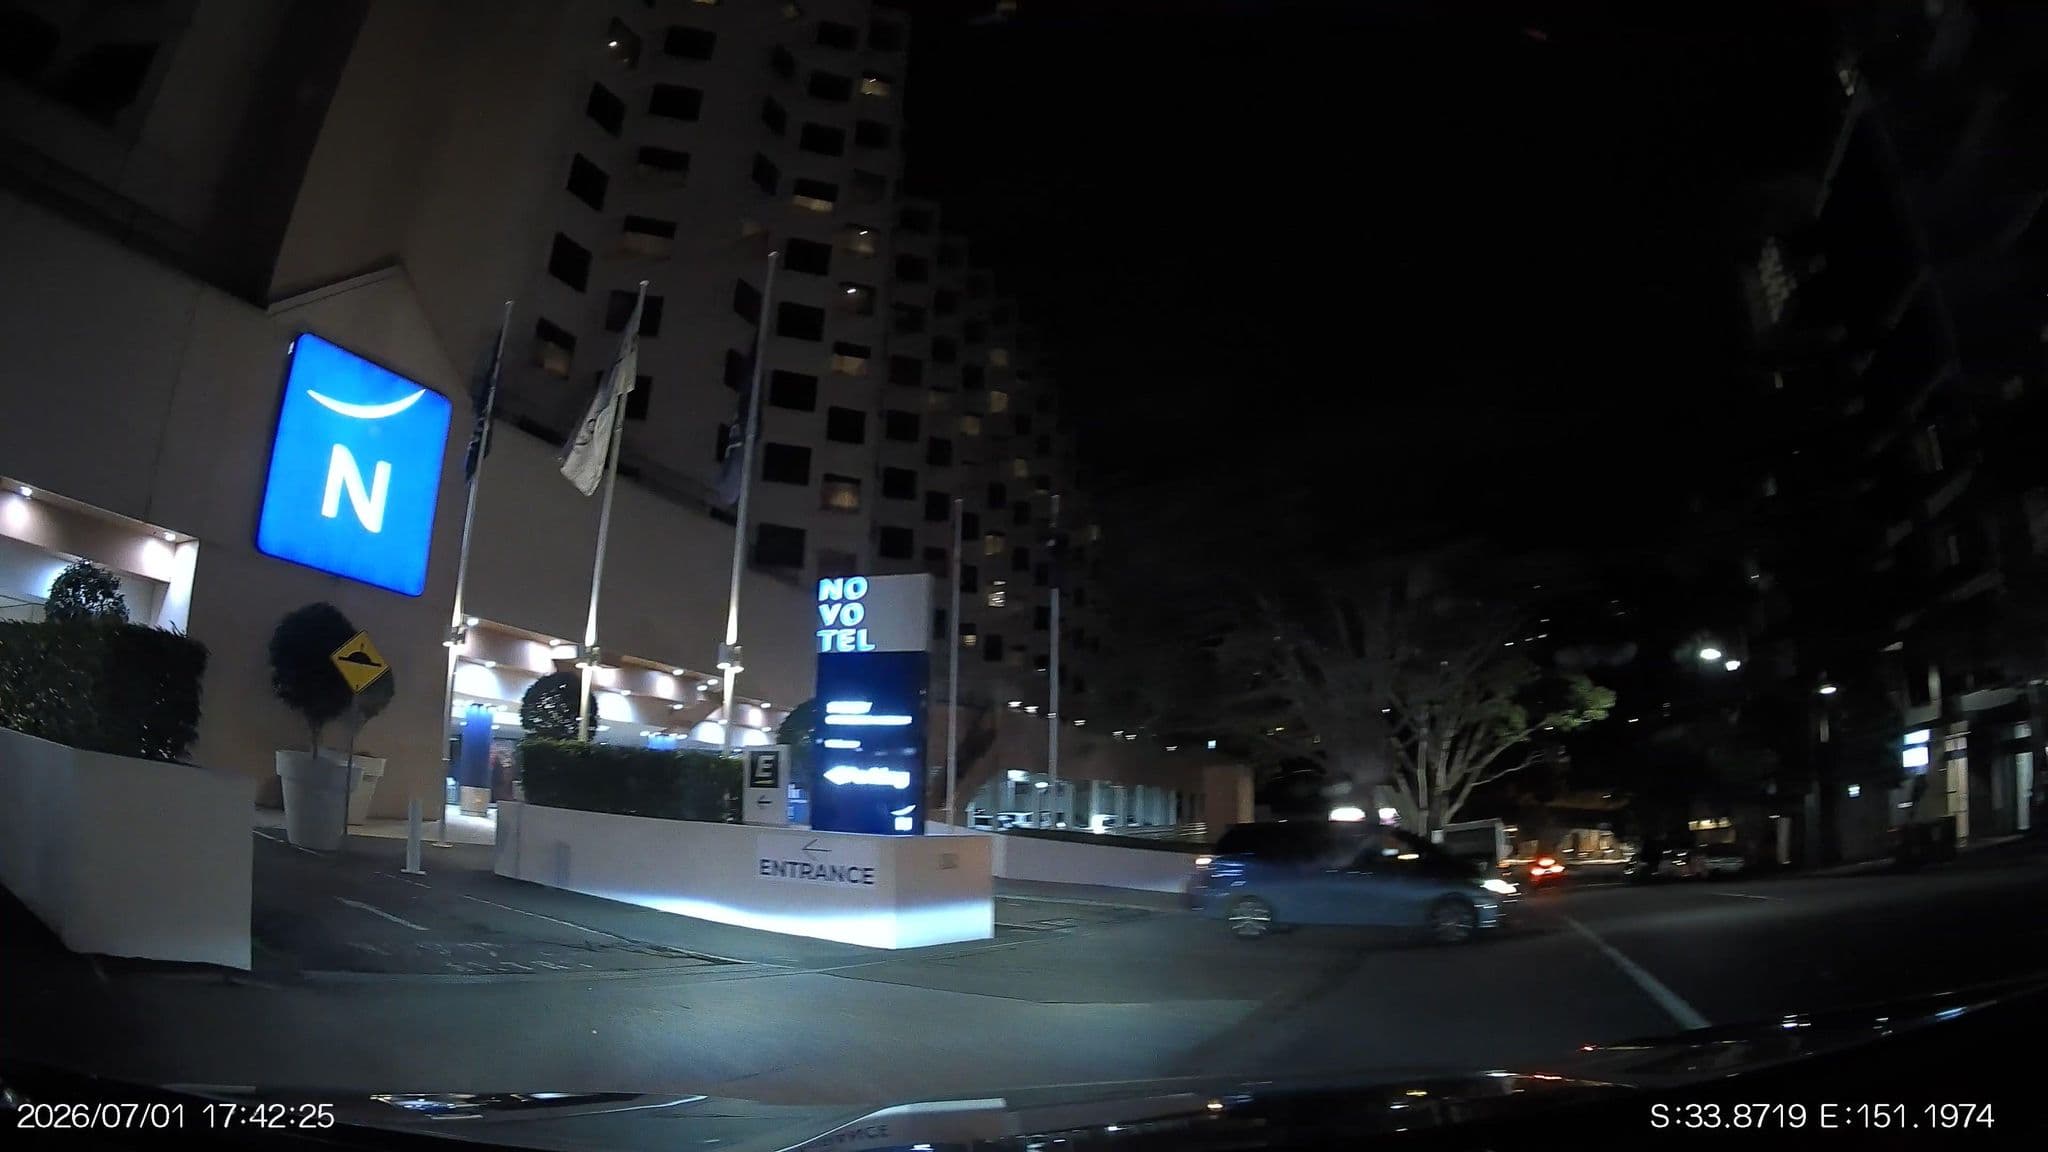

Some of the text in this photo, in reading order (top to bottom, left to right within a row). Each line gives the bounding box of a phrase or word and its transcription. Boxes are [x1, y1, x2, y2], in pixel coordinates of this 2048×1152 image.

[322, 443, 391, 533] N
[818, 576, 868, 601] NO
[818, 602, 865, 627] VO
[816, 628, 876, 653] TEL
[755, 755, 776, 777] E
[760, 859, 876, 885] ENTRANCE
